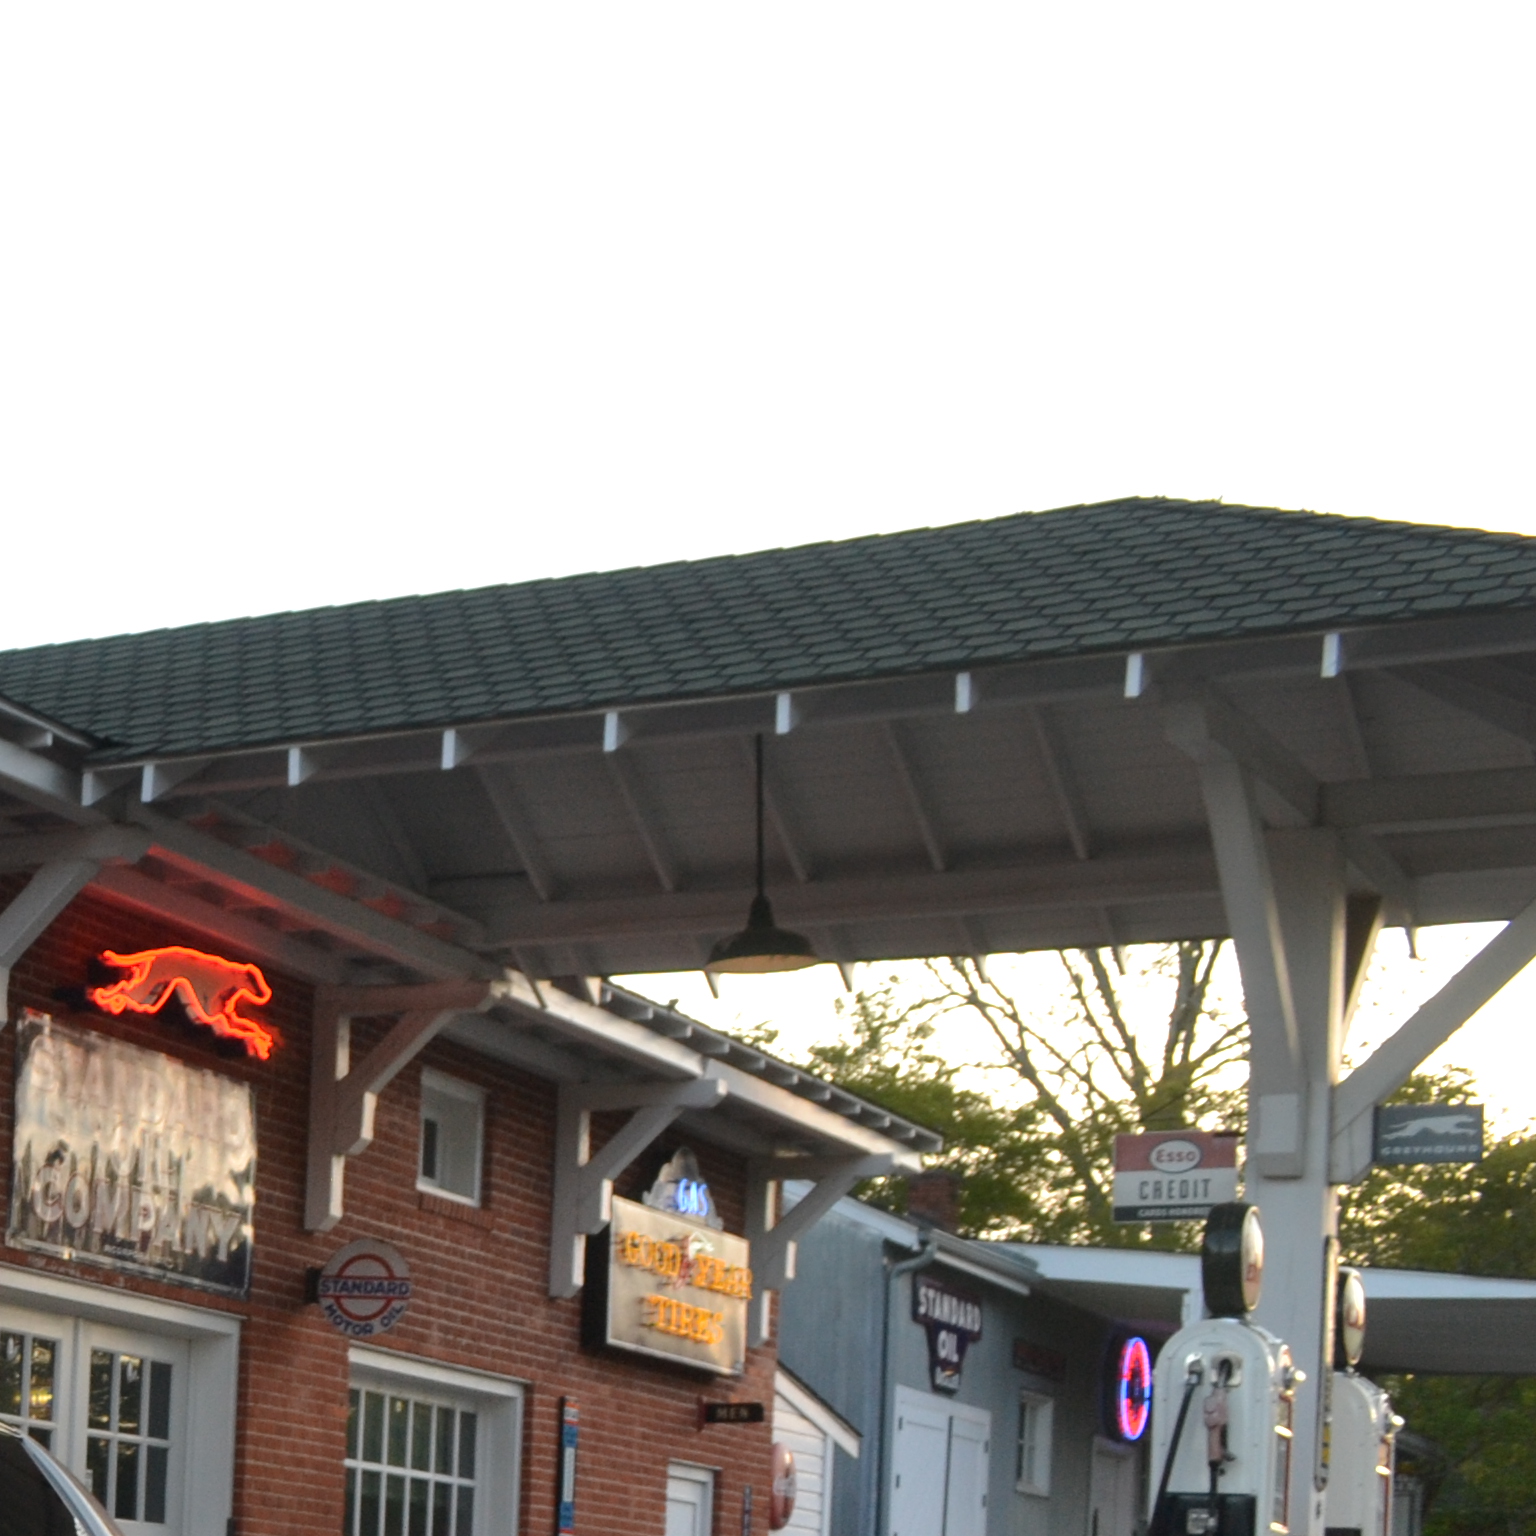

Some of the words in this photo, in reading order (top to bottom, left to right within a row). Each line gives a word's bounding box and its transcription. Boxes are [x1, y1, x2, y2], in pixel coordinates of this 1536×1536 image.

[1155, 1148, 1196, 1163] Esso
[677, 1178, 709, 1216] GAS
[1138, 1178, 1212, 1200] CREDIT
[32, 1163, 241, 1263] COMPANY
[320, 1280, 410, 1296] STANDARD
[324, 1303, 374, 1336] MOTOR
[380, 1304, 405, 1328] OIL
[645, 1293, 725, 1345] TIRES
[918, 1285, 982, 1332] STANDARD
[936, 1329, 960, 1364] OIL
